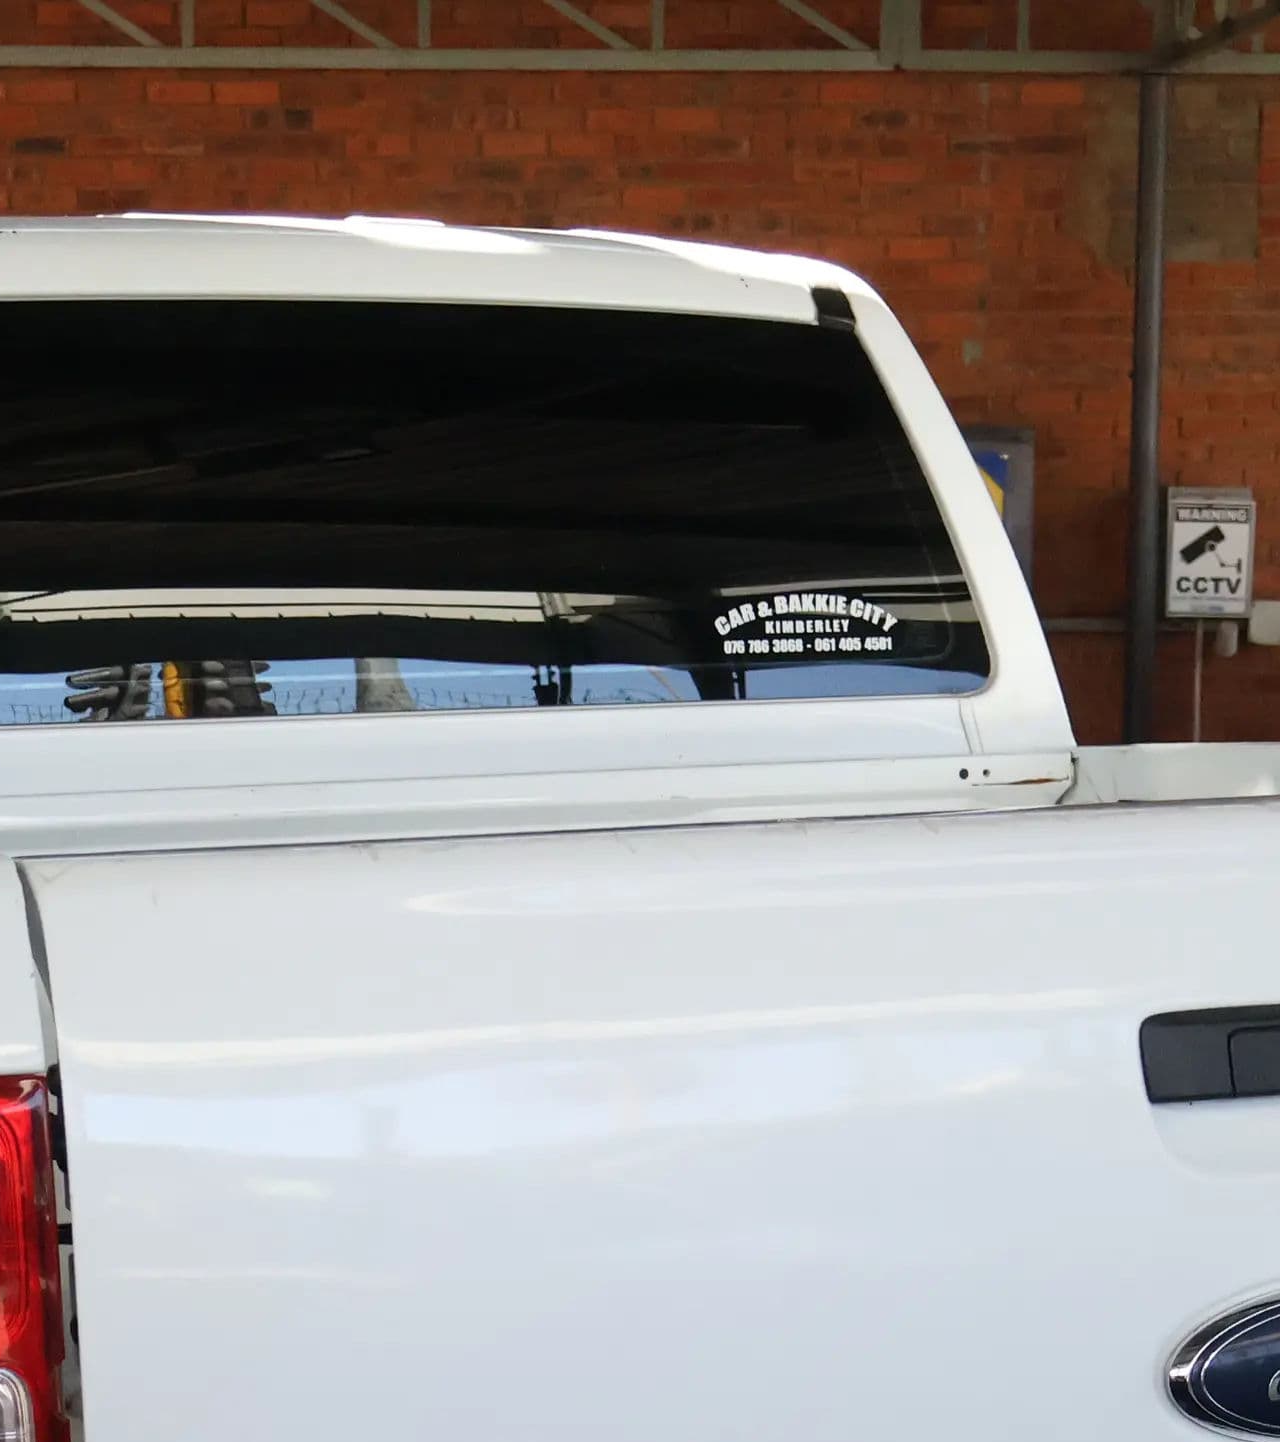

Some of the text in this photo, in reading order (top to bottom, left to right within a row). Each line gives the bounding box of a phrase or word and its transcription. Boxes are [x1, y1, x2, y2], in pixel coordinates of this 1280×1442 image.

[1176, 576, 1241, 594] CCTV
[714, 593, 898, 635] CAR & BAKKIE CITY
[765, 619, 850, 634] KIMBERLEY
[724, 640, 745, 654] 076
[814, 638, 835, 651] 061
[838, 637, 861, 651] 405
